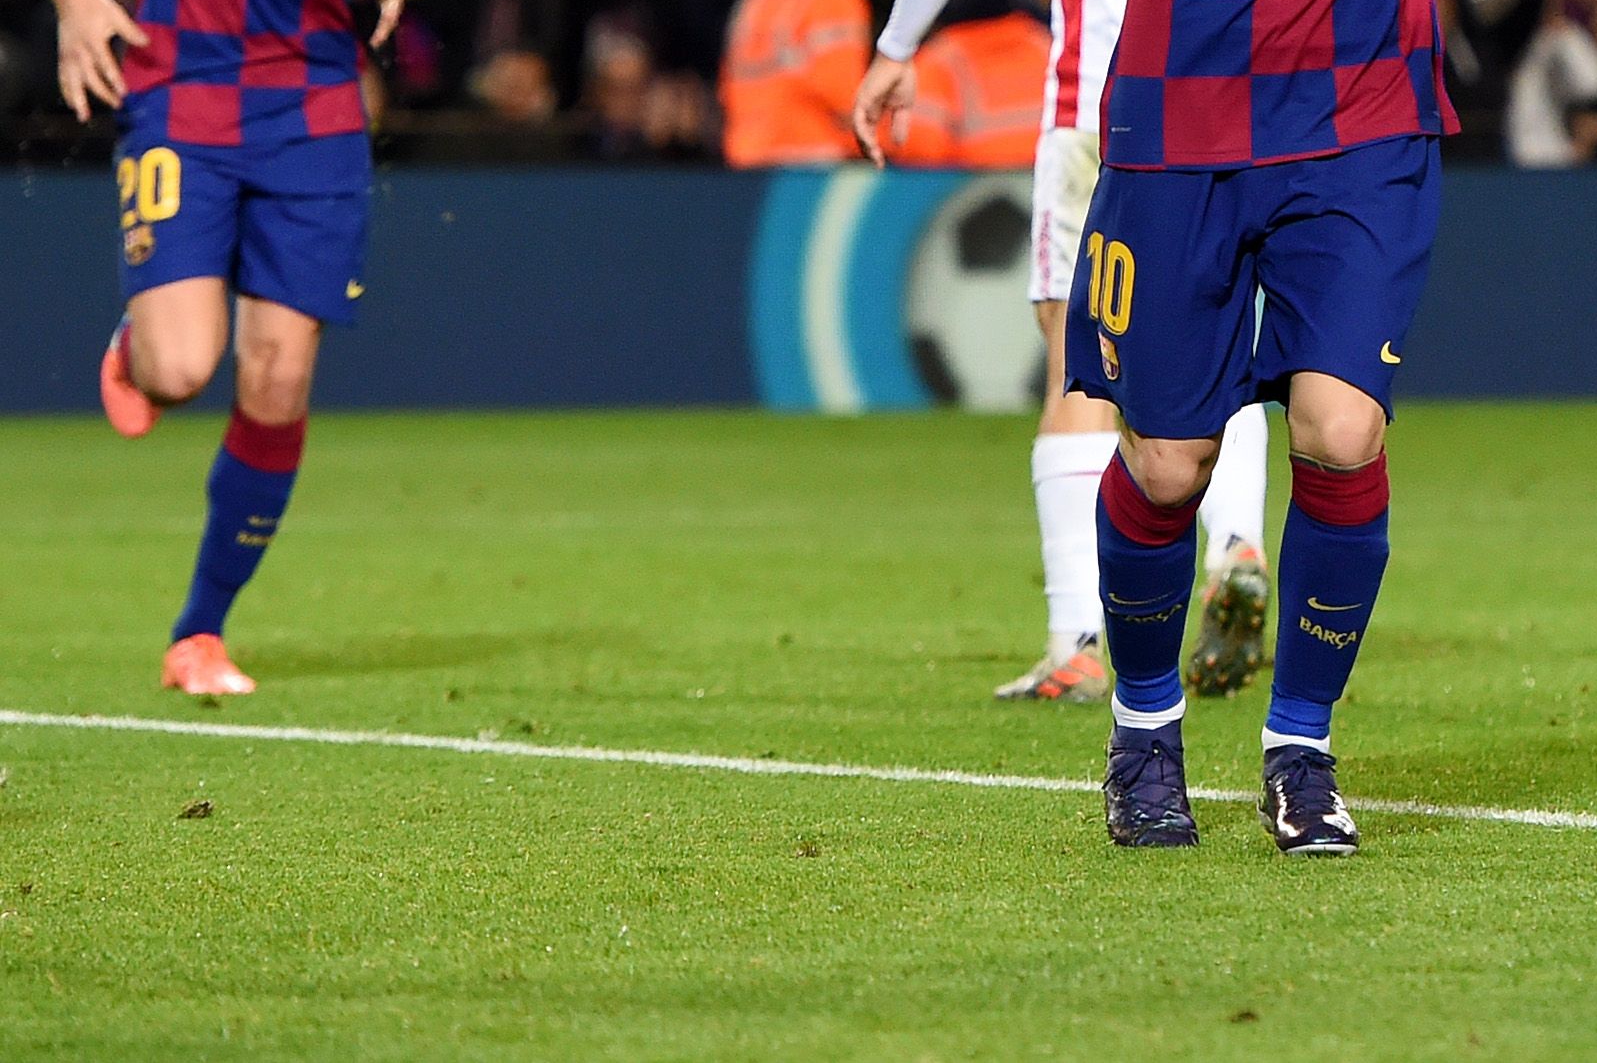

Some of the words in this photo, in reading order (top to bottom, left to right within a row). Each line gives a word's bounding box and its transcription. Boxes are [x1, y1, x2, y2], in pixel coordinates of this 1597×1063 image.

[117, 147, 181, 229] 20
[1086, 231, 1136, 336] 10
[1299, 616, 1358, 650] BARÇA
